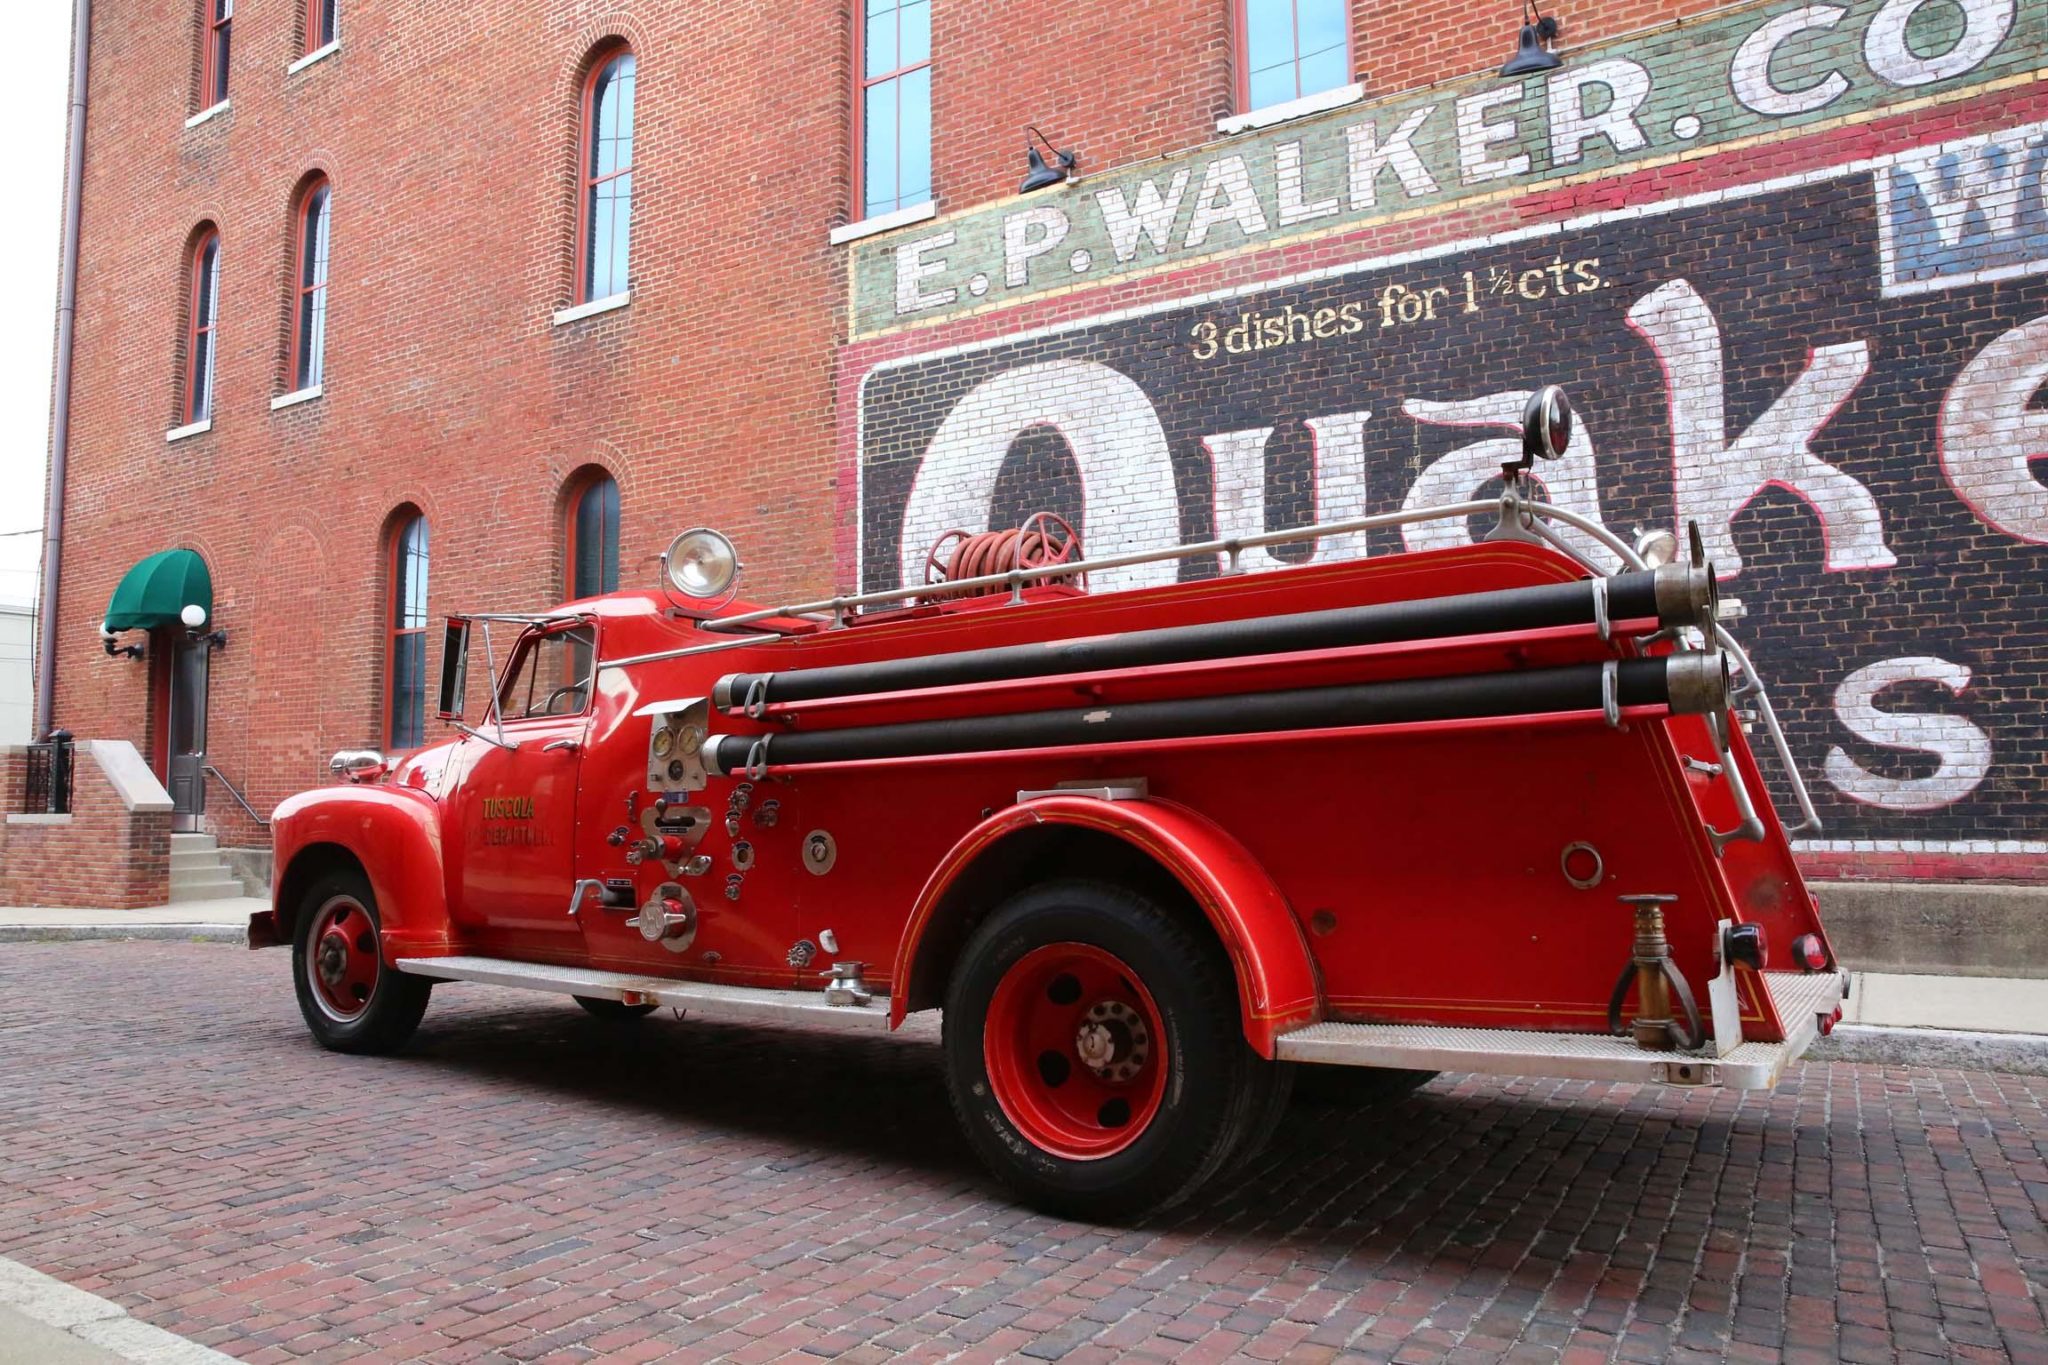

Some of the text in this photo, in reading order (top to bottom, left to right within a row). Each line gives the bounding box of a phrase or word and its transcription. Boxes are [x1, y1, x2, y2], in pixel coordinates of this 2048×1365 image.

[1191, 321, 1218, 360] 3
[1224, 300, 1364, 355] dishes
[1377, 284, 1449, 328] for
[482, 797, 534, 819] TUSCOLA
